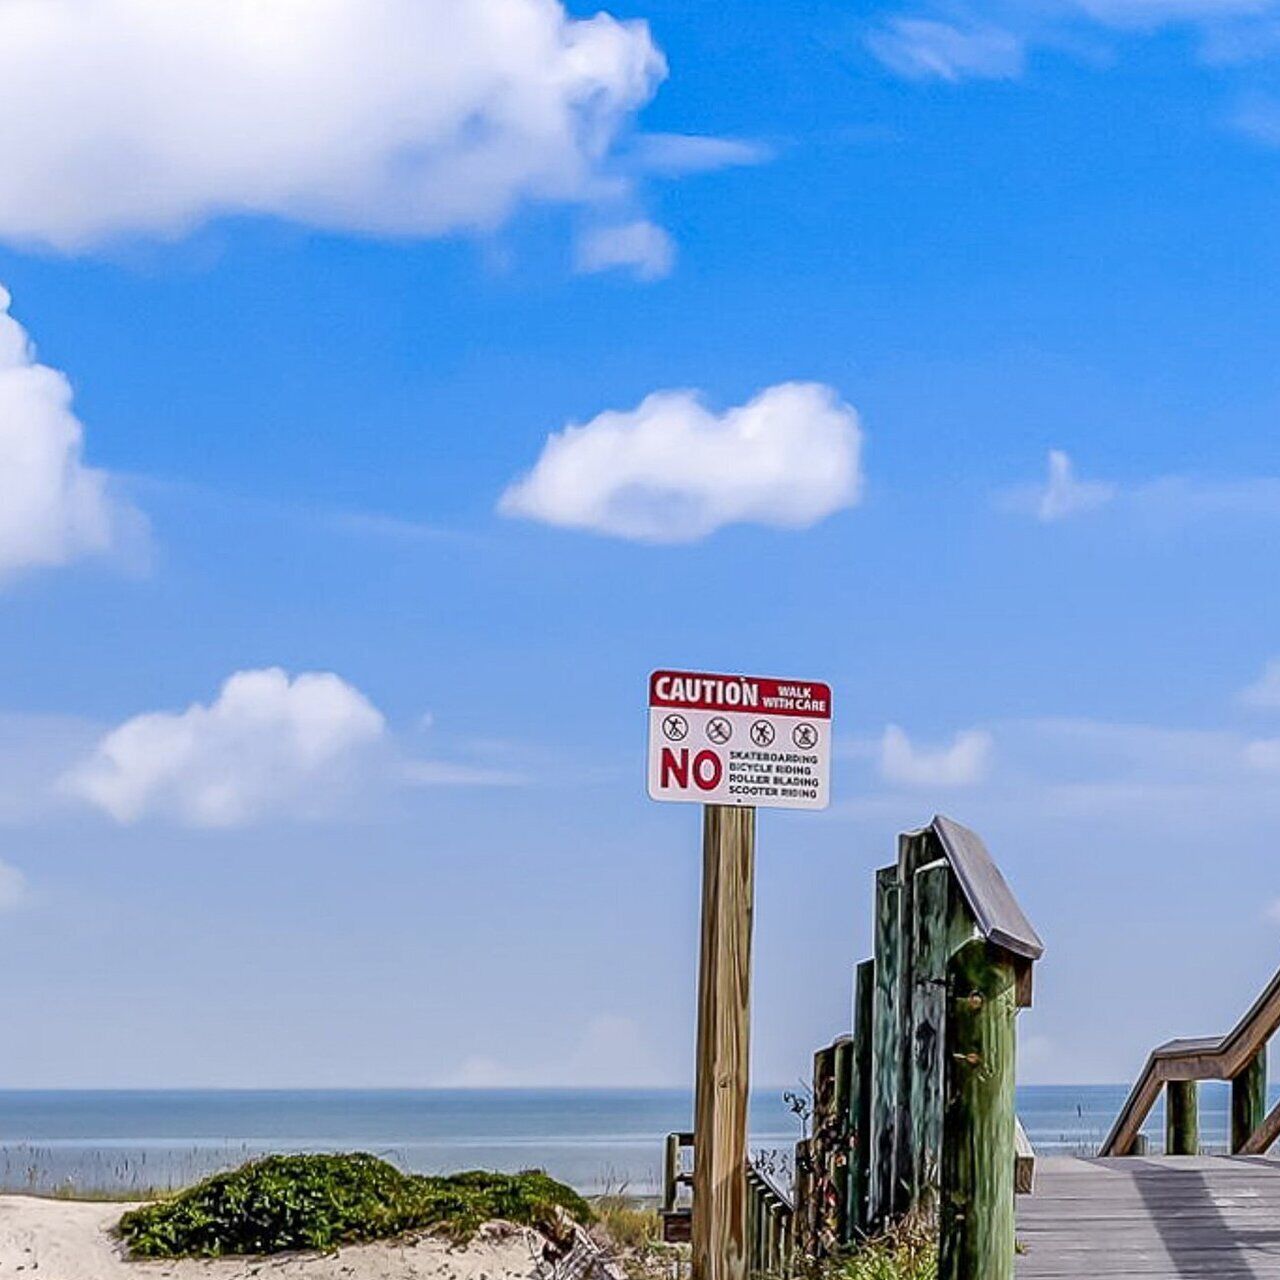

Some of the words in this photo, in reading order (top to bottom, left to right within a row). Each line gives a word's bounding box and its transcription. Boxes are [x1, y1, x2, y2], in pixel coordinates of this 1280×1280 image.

[655, 677, 759, 707] CAUTION
[778, 686, 811, 698] WALK
[762, 697, 794, 709] WITH
[795, 699, 826, 712] CARE
[730, 751, 817, 764] SKATEBOARDING
[661, 748, 722, 790] NO
[729, 763, 772, 773] BICYCLE
[776, 765, 811, 775] RIDING
[729, 774, 769, 785] ROLLER
[773, 776, 819, 787] BLADING
[729, 786, 778, 796] SCOOTER
[781, 789, 816, 798] RIDING
